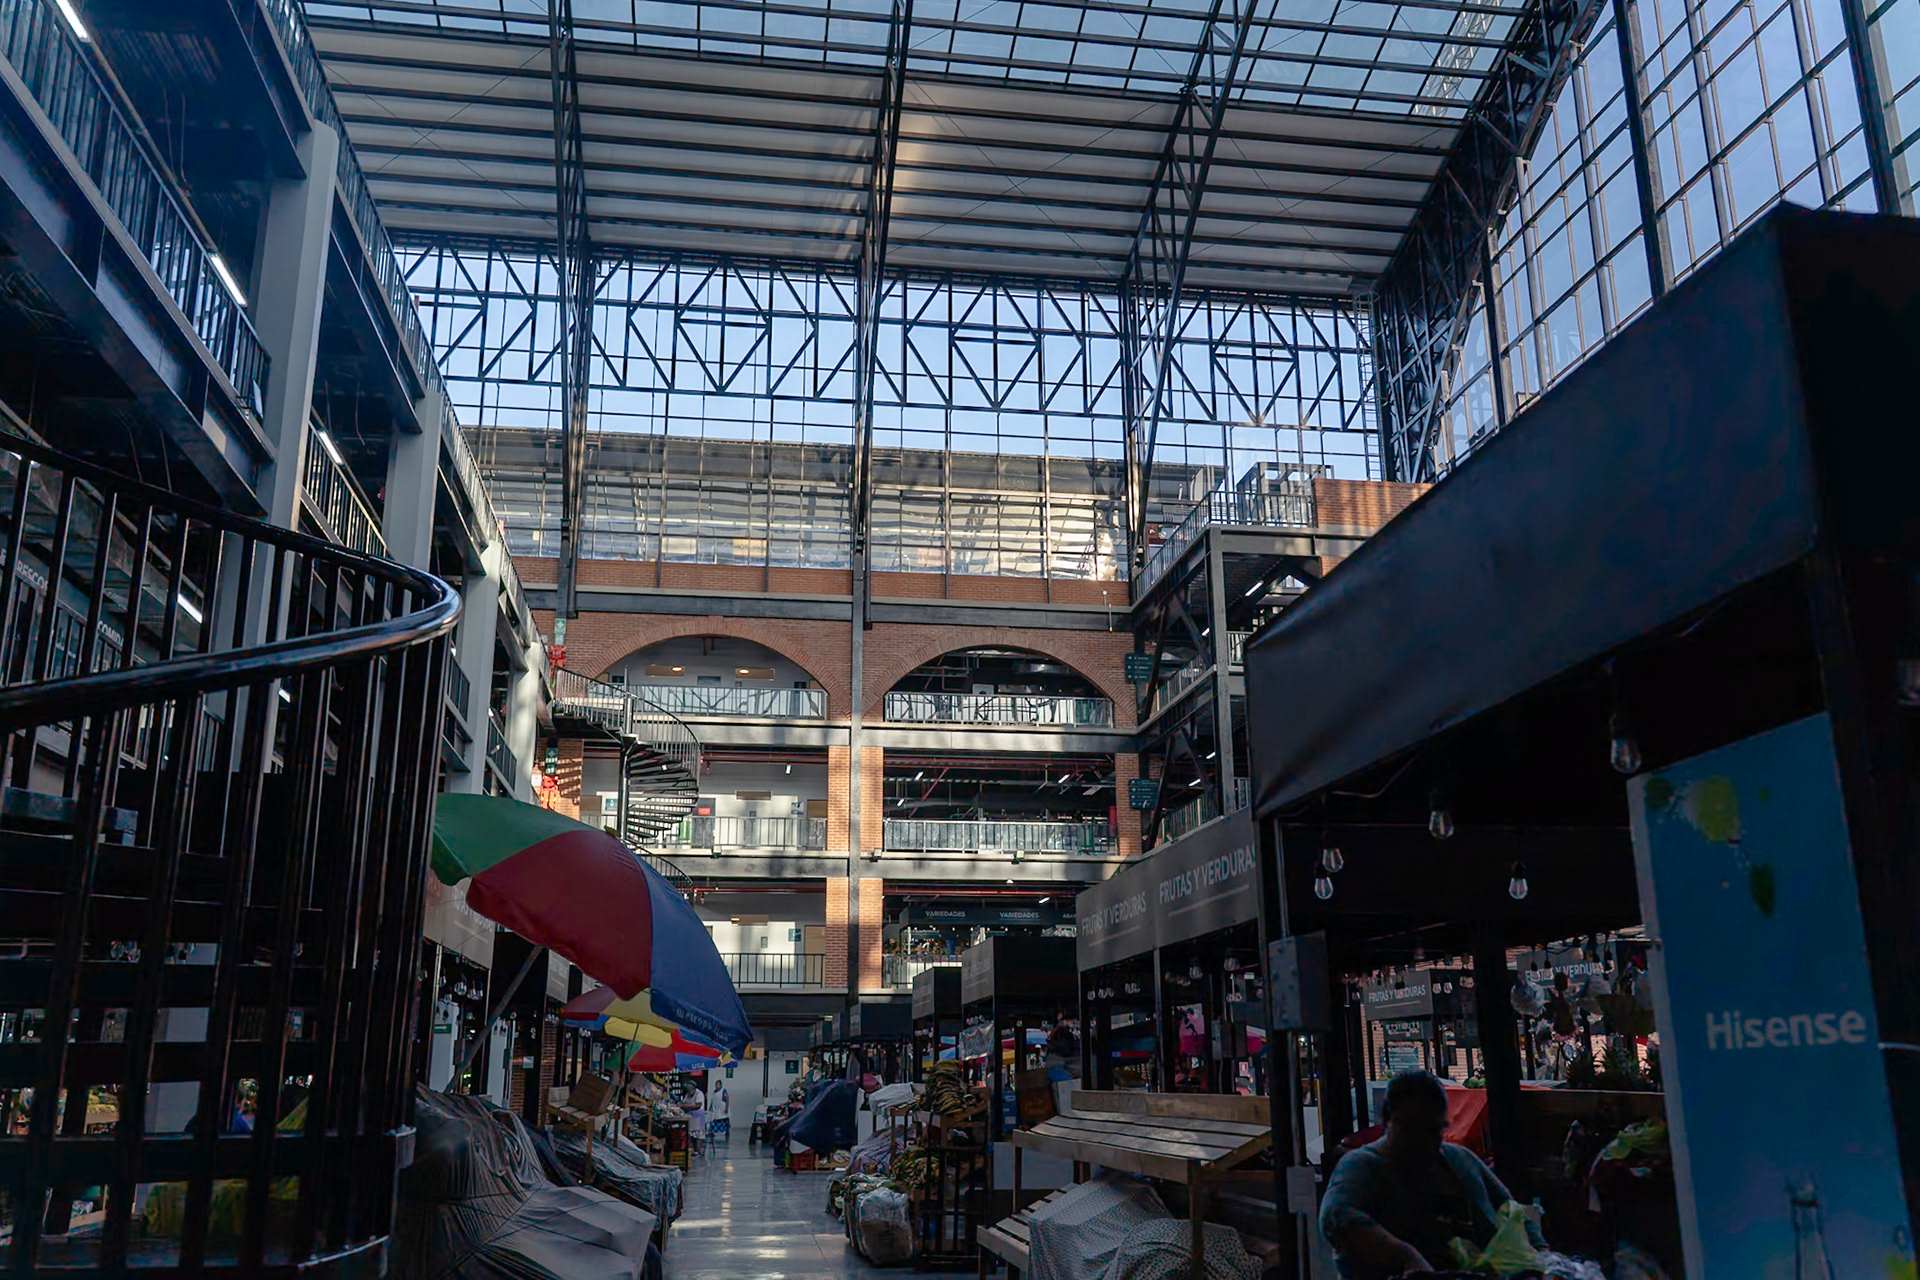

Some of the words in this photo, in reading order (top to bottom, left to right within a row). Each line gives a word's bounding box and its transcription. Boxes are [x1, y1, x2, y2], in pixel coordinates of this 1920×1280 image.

[1159, 870, 1192, 905] FRUTAS
[1193, 866, 1200, 892] Y
[924, 910, 967, 918] VARIEDADES
[999, 911, 1040, 919] VARIEDADES
[1081, 907, 1103, 937] FRUTAS
[1103, 909, 1109, 928] Y
[1108, 890, 1147, 925] VERDURAS
[1368, 988, 1389, 1003] FRUTAS
[1388, 989, 1395, 1001] Y
[1705, 1009, 1868, 1050] Hisense
